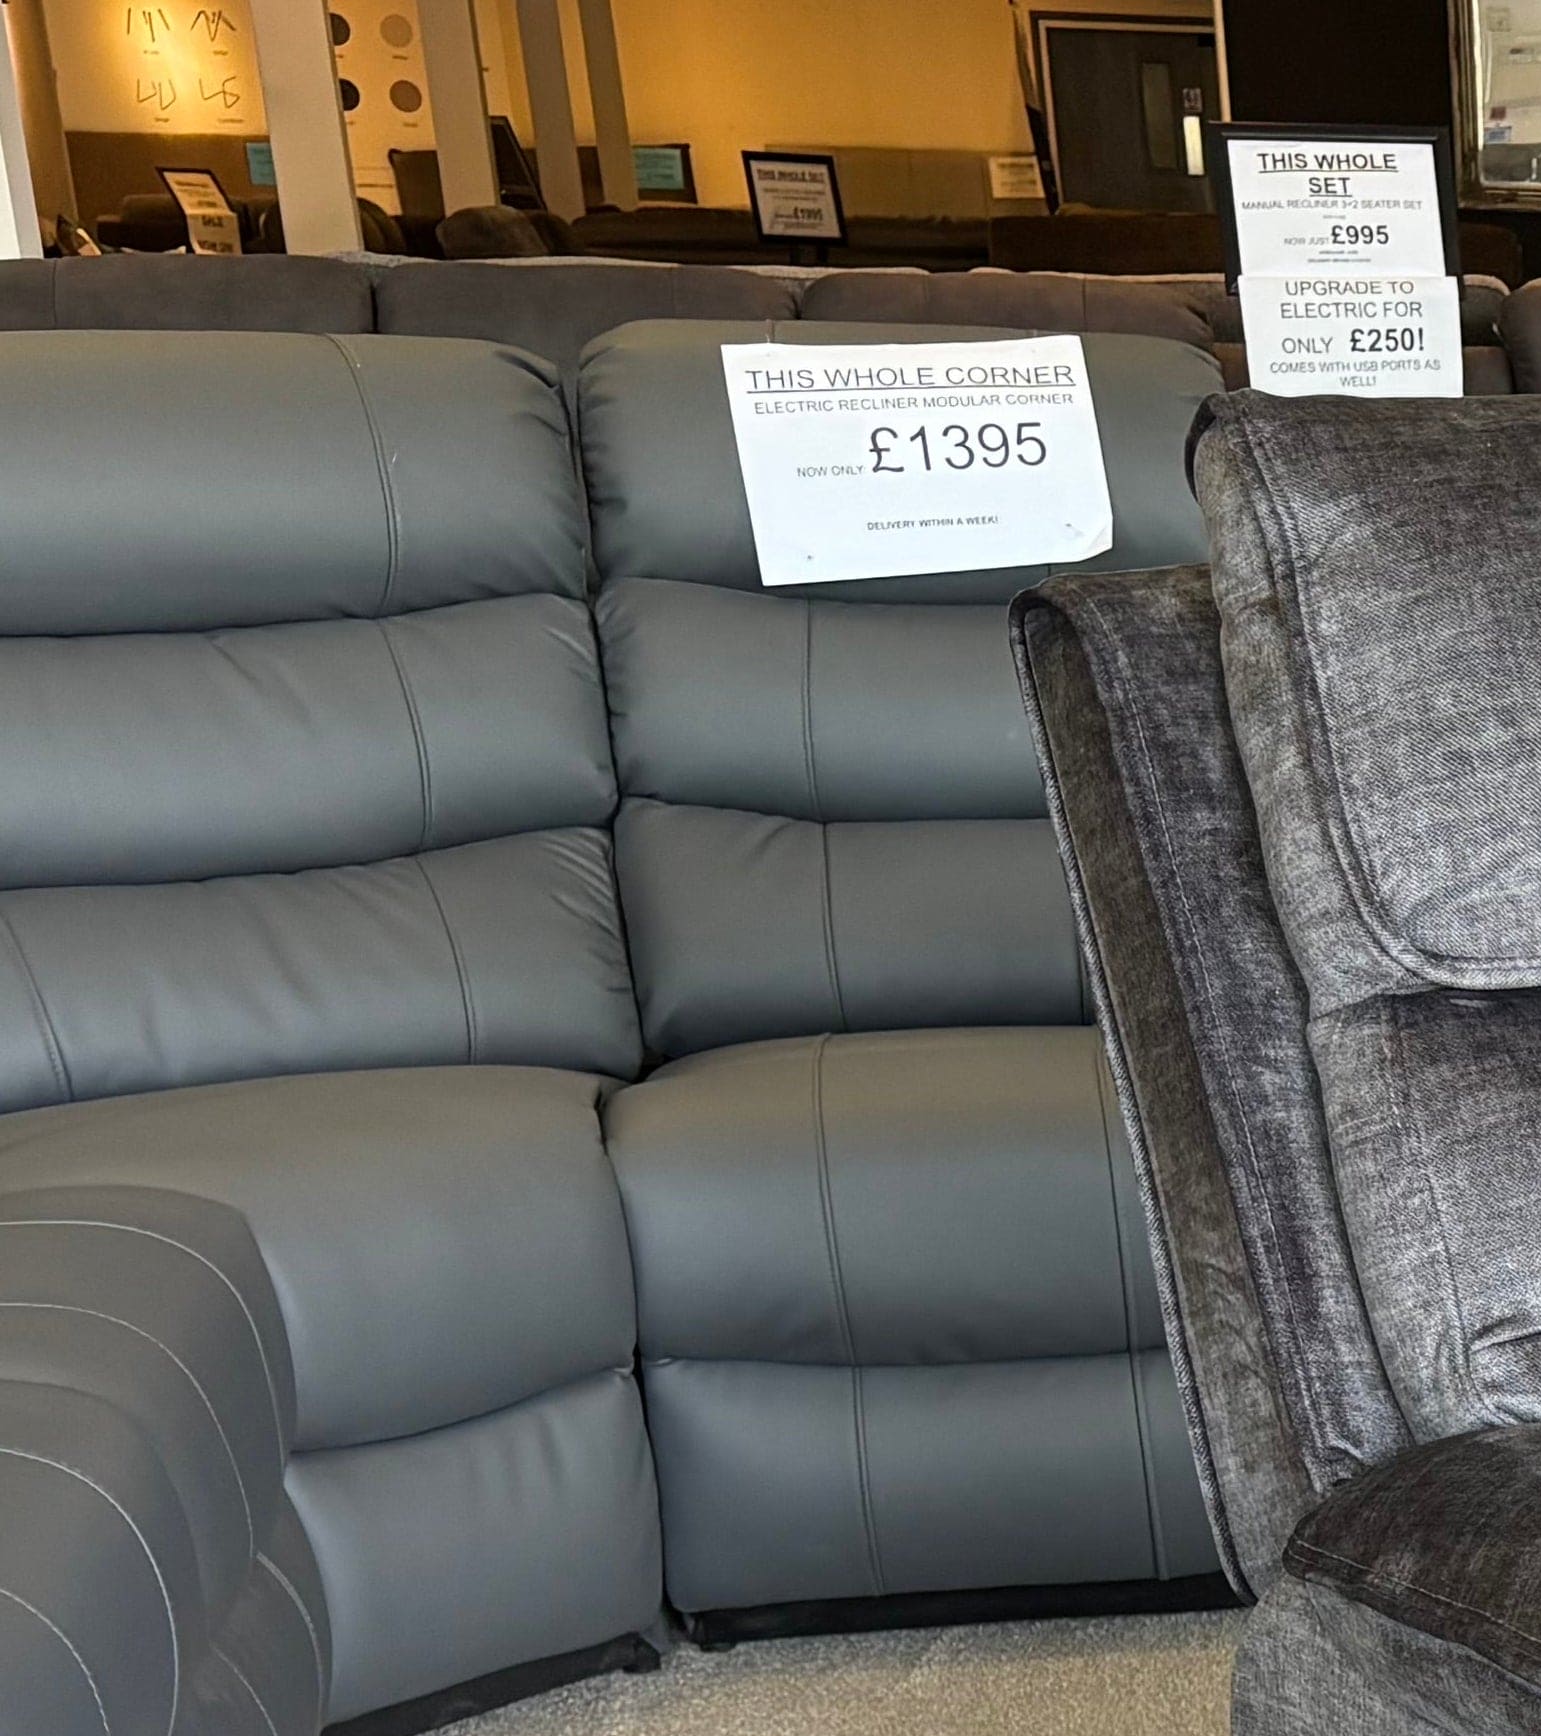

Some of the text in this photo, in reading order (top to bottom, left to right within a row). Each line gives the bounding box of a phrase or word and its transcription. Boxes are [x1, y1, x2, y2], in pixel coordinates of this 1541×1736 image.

[1257, 153, 1398, 170] THIS WHOLE
[1308, 177, 1352, 194] SET
[1242, 200, 1284, 210] MANUAL
[1287, 199, 1339, 210] RECLINER
[1362, 199, 1401, 210] SEATER
[1403, 199, 1423, 210] SET
[1331, 225, 1390, 245] £995
[1285, 281, 1415, 296] UPGRADE TO
[1280, 302, 1424, 319] ELECTRIC FOR
[1281, 327, 1425, 354] ONLY £250!
[1270, 359, 1441, 374] COMES WITH USB PORTS AS
[745, 364, 1075, 390] THIS WHOLE CORNER
[754, 392, 1074, 415] ELECTRIC RECLINER MODULAR CORNER
[797, 466, 829, 478] NOW
[869, 422, 1048, 473] £1395
[867, 516, 999, 531] DELIVERY WITHIN A WEEK!
